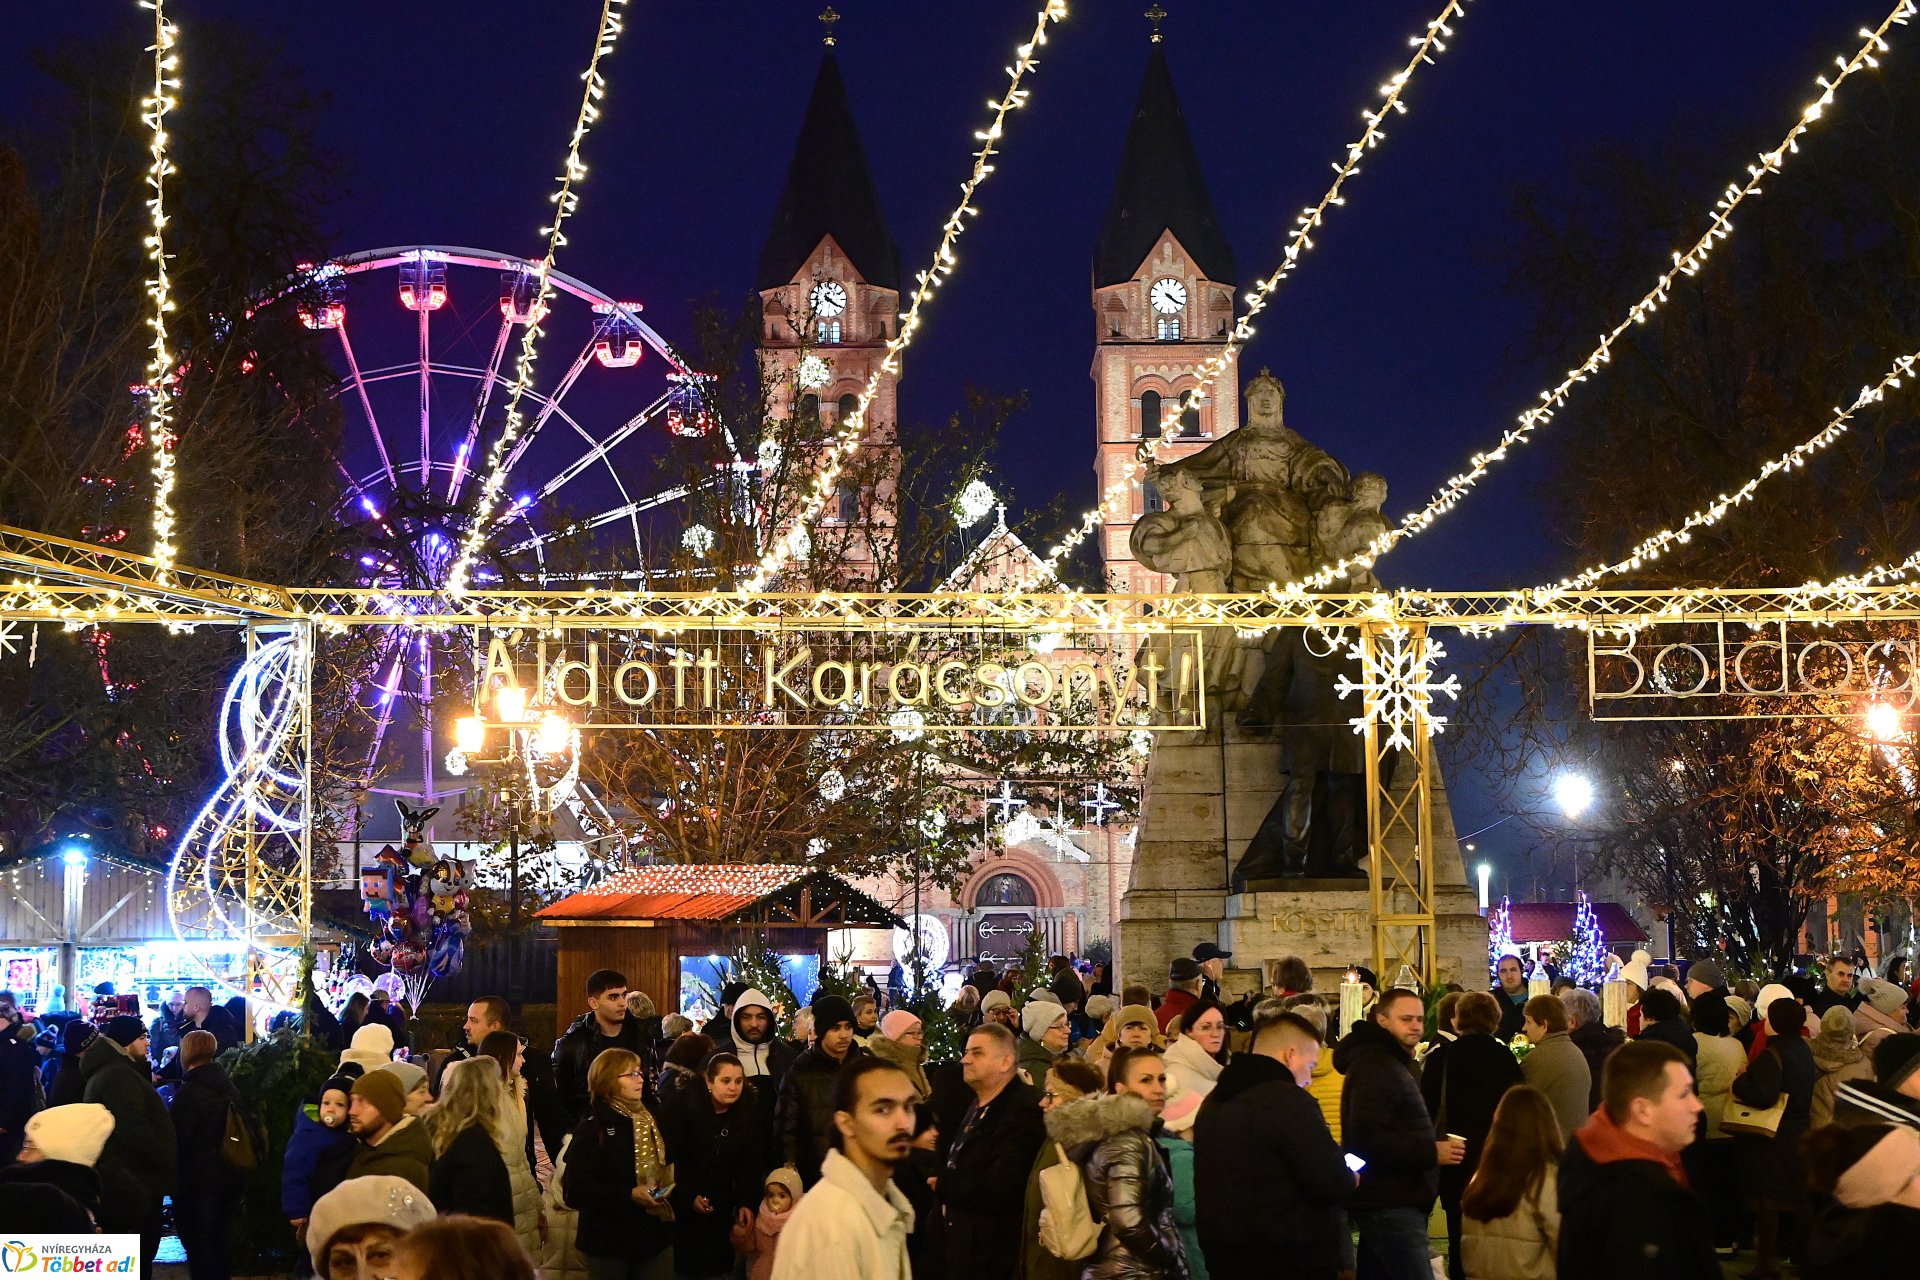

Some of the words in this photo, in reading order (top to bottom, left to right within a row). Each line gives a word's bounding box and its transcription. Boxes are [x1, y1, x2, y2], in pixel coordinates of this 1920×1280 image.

[479, 628, 720, 708] Áldott
[765, 635, 1192, 726] Karácsonyt!
[1589, 619, 1917, 712] Boldog
